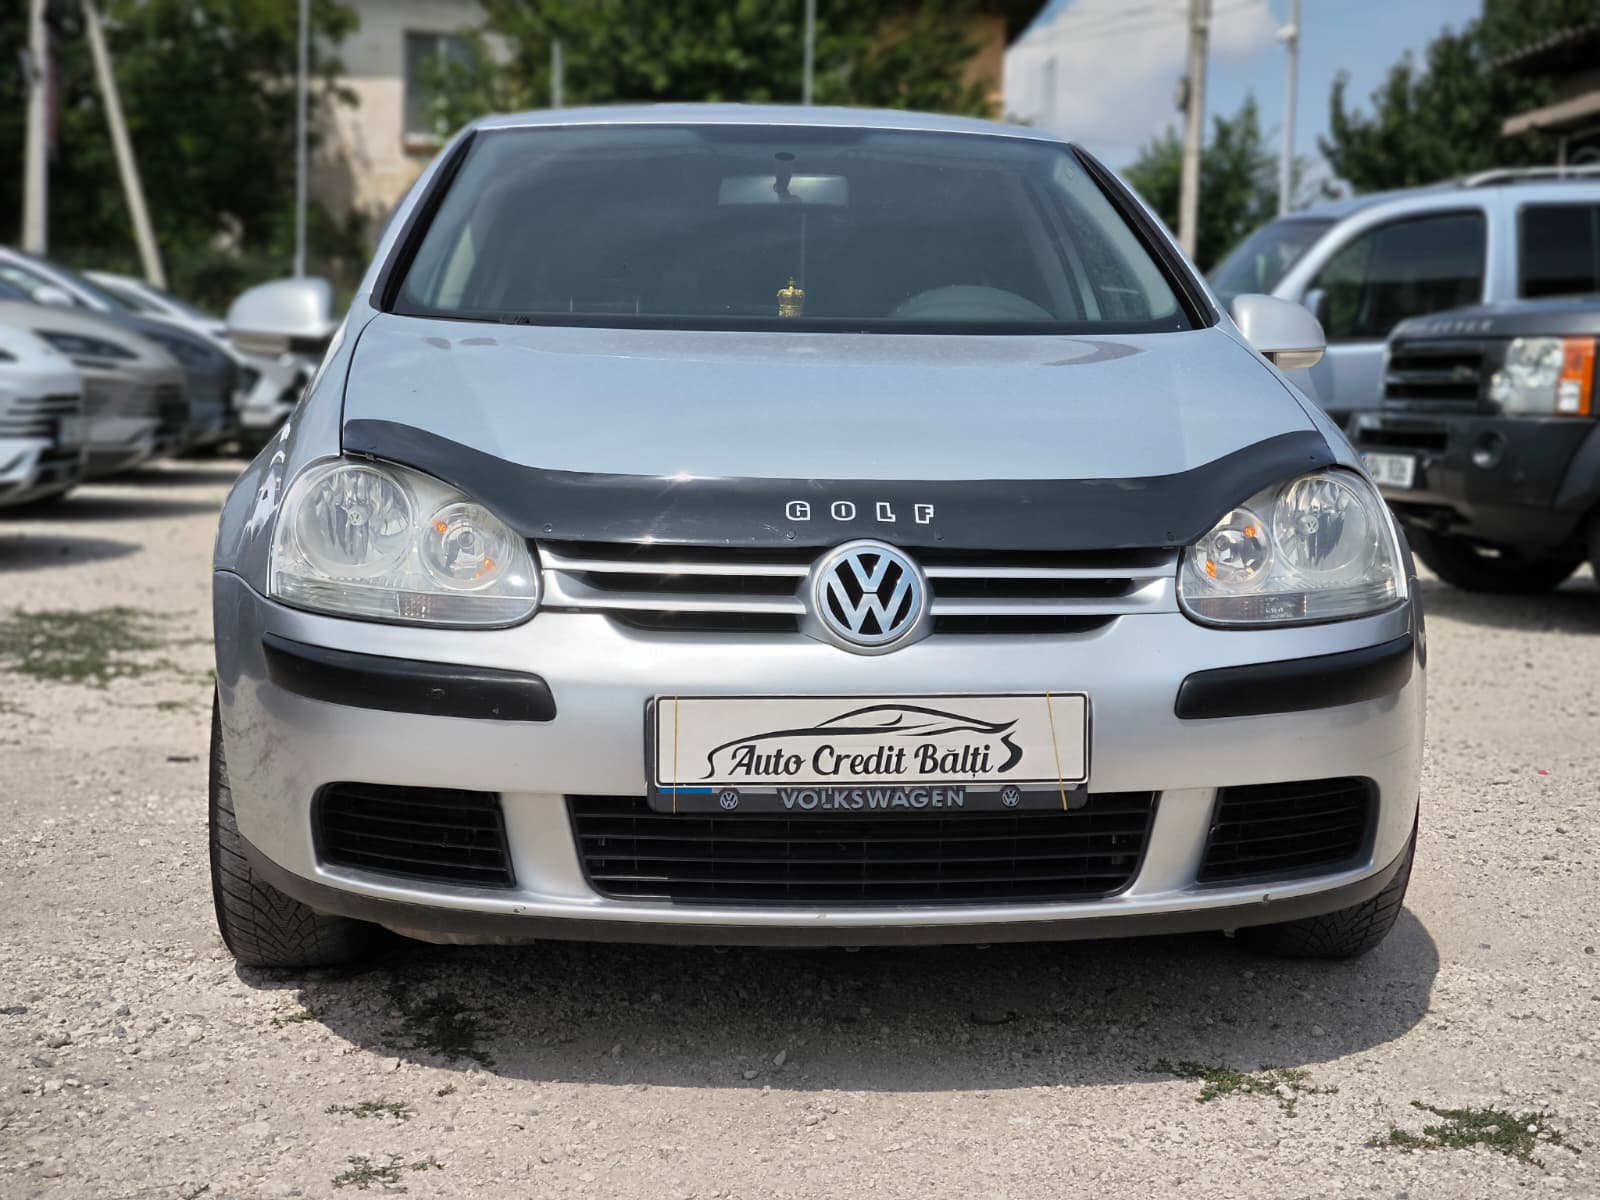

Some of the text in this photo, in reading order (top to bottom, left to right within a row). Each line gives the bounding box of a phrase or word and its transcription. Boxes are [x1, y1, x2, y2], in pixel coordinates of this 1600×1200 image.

[785, 500, 934, 524] GOLF
[817, 544, 923, 643] VW
[728, 744, 806, 776] Auto
[812, 744, 908, 776] Credit
[780, 788, 965, 810] VOLKSWAGEN
